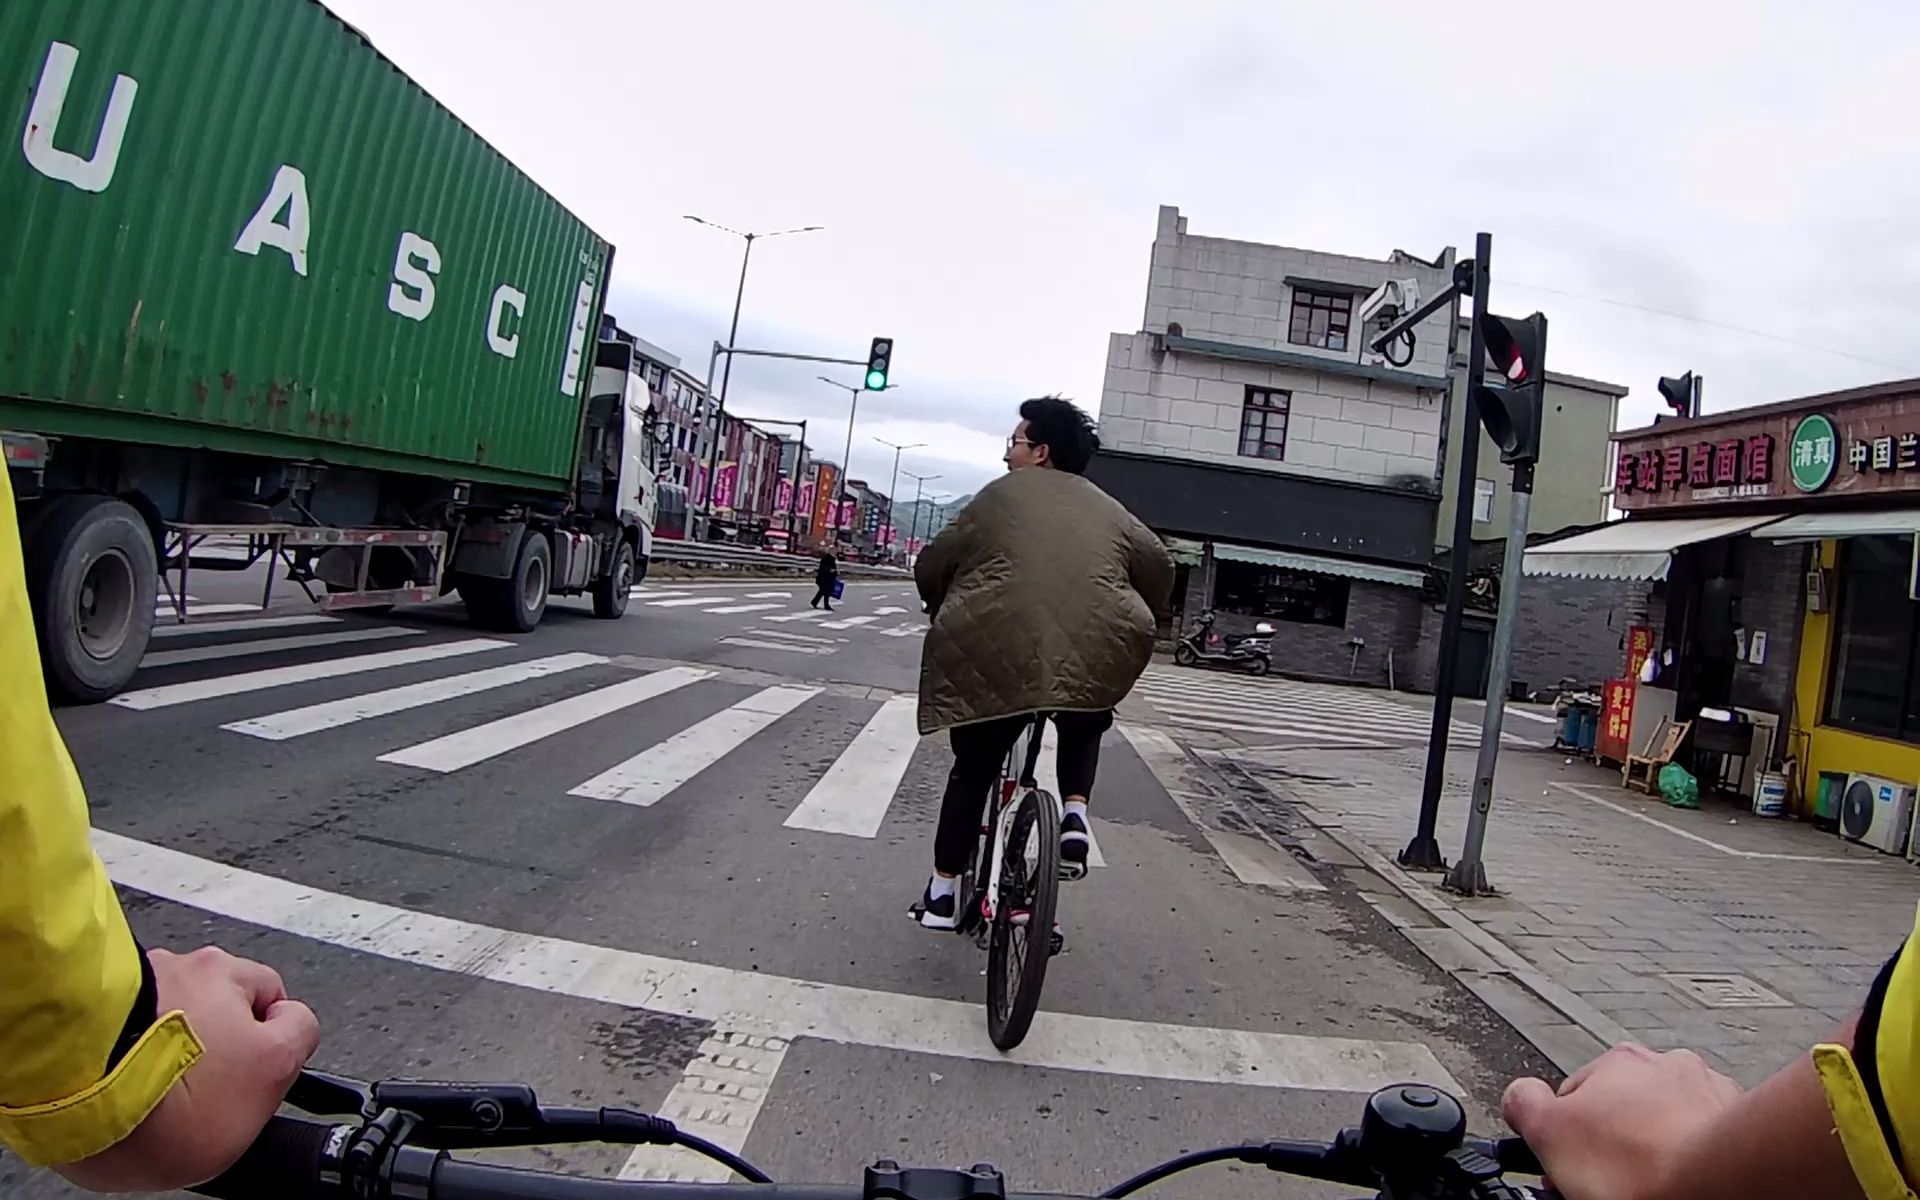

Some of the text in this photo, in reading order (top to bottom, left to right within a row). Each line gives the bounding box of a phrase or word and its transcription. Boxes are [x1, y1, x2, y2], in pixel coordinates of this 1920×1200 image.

[1795, 436, 1830, 467] 清真
[1849, 433, 1918, 471] 中国兰
